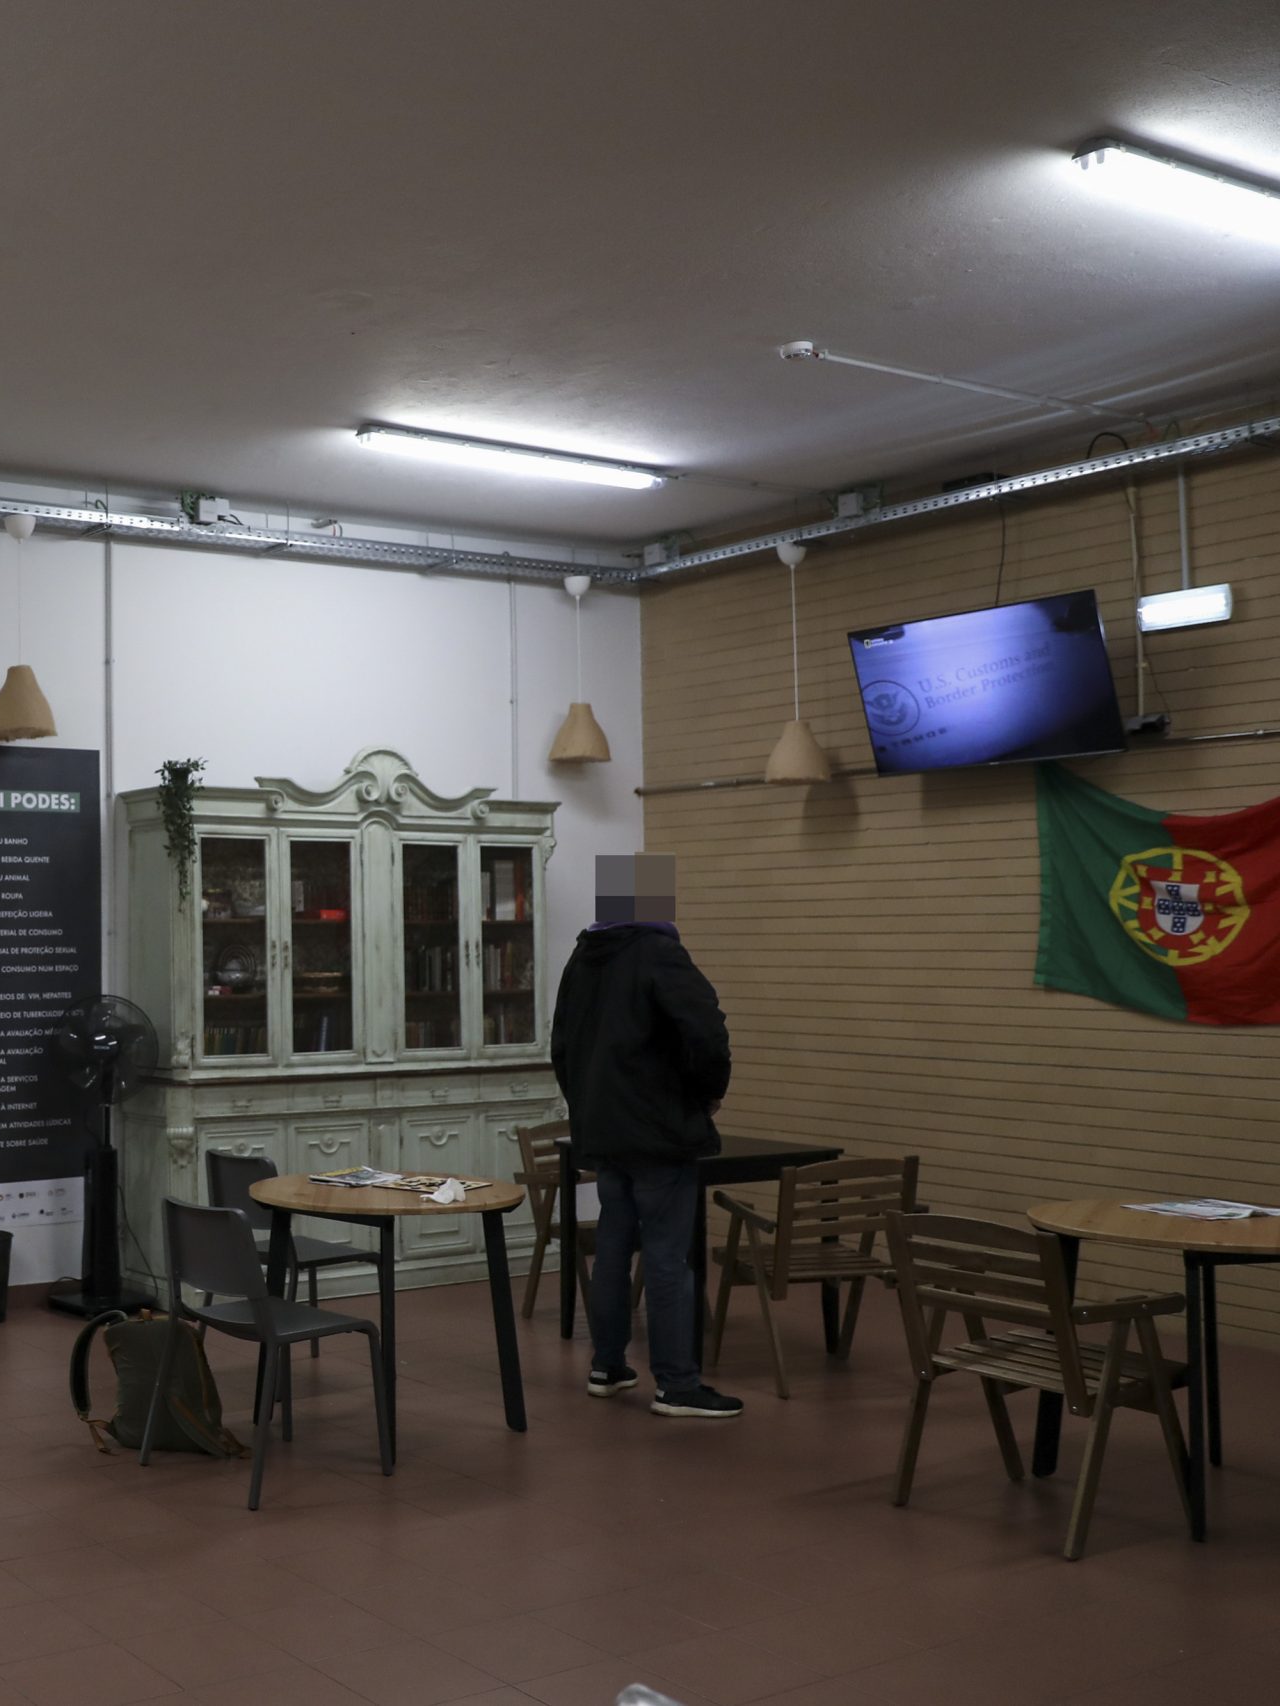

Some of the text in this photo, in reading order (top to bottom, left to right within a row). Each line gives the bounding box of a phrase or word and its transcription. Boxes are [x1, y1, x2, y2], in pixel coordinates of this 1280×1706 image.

[918, 642, 1051, 693] U.S. Customs and
[924, 685, 977, 709] Border
[11, 792, 76, 810] PODES:
[4, 838, 29, 846] BANHO
[24, 856, 50, 864] QUENTE
[4, 874, 30, 882] ANIMAL
[1, 892, 24, 900] ROUPA
[28, 928, 63, 936] CONSUMO
[11, 947, 19, 955] DE
[20, 945, 54, 955] PROTEÇÃO
[1, 965, 37, 973] CONSUMO
[55, 964, 79, 973] ESPAÇO
[42, 991, 72, 999] HEPATITES
[13, 1011, 21, 1019] DE
[6, 1028, 43, 1037] AVALIAÇÃO
[6, 1046, 44, 1056] AVALIAÇÃO
[6, 1075, 38, 1083] SERVIÇOS
[7, 1102, 38, 1110] INTERNET
[9, 1120, 45, 1129] ATIVIDADES
[6, 1139, 27, 1148] SOBRE
[28, 1137, 49, 1146] SAÚDE
